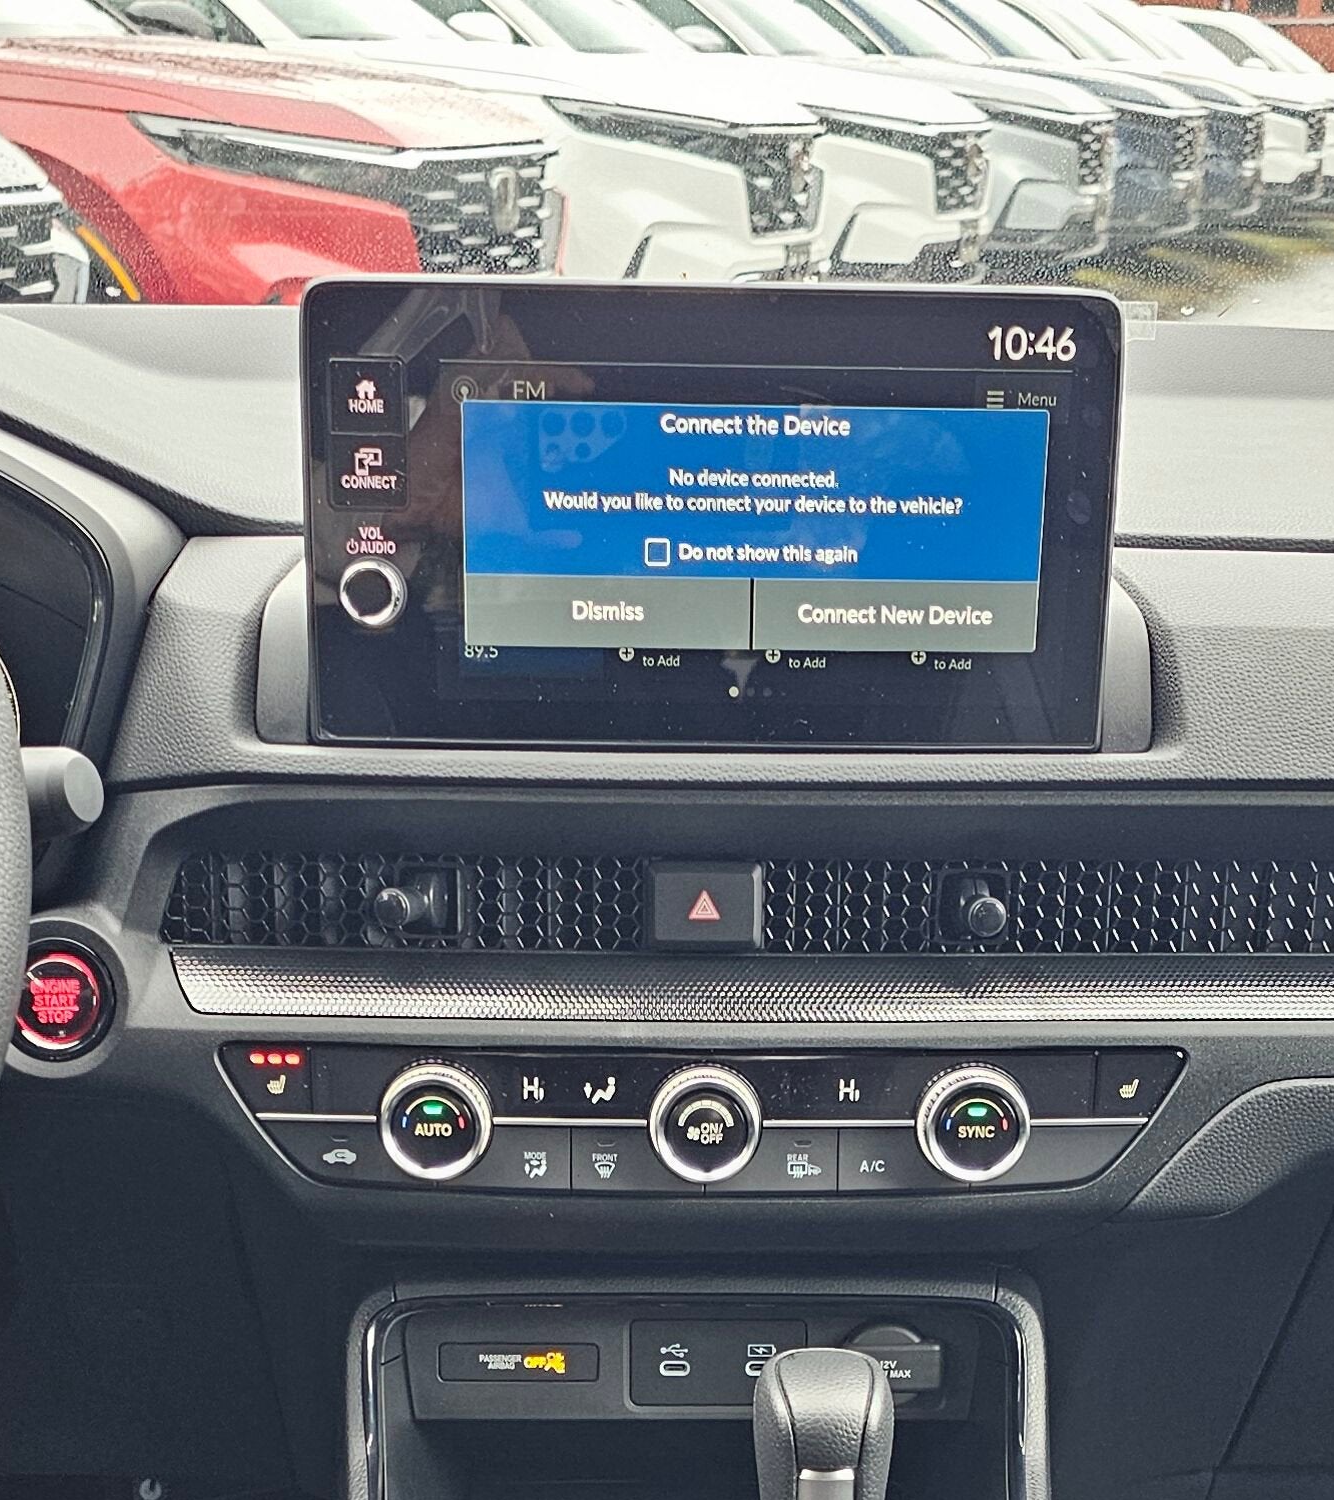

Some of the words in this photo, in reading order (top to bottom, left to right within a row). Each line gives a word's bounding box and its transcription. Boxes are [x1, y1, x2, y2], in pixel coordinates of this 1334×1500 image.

[987, 325, 1077, 362] 10:46
[513, 381, 545, 400] FM
[348, 399, 384, 414] HOME
[1017, 391, 1057, 408] Menu
[660, 413, 745, 435] Connect
[747, 414, 779, 436] the
[784, 415, 851, 437] Device
[341, 475, 397, 490] CONNECT
[669, 469, 694, 486] No
[697, 469, 749, 487] device
[751, 470, 839, 489] connected.
[544, 490, 597, 510] Would
[600, 495, 631, 512] you
[636, 492, 662, 511] like
[666, 495, 685, 511] to
[687, 496, 751, 512] connect
[754, 498, 791, 515] your
[795, 495, 846, 513] device
[848, 498, 866, 514] to
[870, 497, 896, 514] the
[899, 497, 963, 515] vehicle?
[358, 526, 384, 540] VOL
[360, 540, 396, 555] AUDIO
[679, 543, 703, 561] Do
[705, 545, 733, 561] not
[736, 544, 780, 562] show
[783, 543, 812, 562] this
[815, 545, 857, 565] again
[572, 600, 644, 621] Dismiss
[797, 604, 876, 624] Connect
[880, 605, 924, 624] New
[929, 606, 993, 626] Device
[464, 645, 499, 659] 89.5
[642, 655, 655, 668] to
[657, 655, 681, 668] Add
[788, 657, 801, 669] to
[802, 657, 826, 669] Add
[934, 658, 946, 670] to
[948, 658, 972, 671] Add
[30, 978, 80, 995] ENGINE
[34, 994, 77, 1007] START
[37, 1010, 74, 1024] STOP
[414, 1123, 452, 1137] AUTO
[700, 1122, 725, 1136] ON/
[957, 1125, 995, 1139] SYNC
[700, 1134, 723, 1146] OFF
[524, 1151, 547, 1160] MODE
[592, 1153, 618, 1162] FRONT
[786, 1153, 809, 1162] REAR
[859, 1160, 885, 1172] A/C
[479, 1354, 522, 1363] PASSENGER
[890, 1370, 911, 1379] MAX
